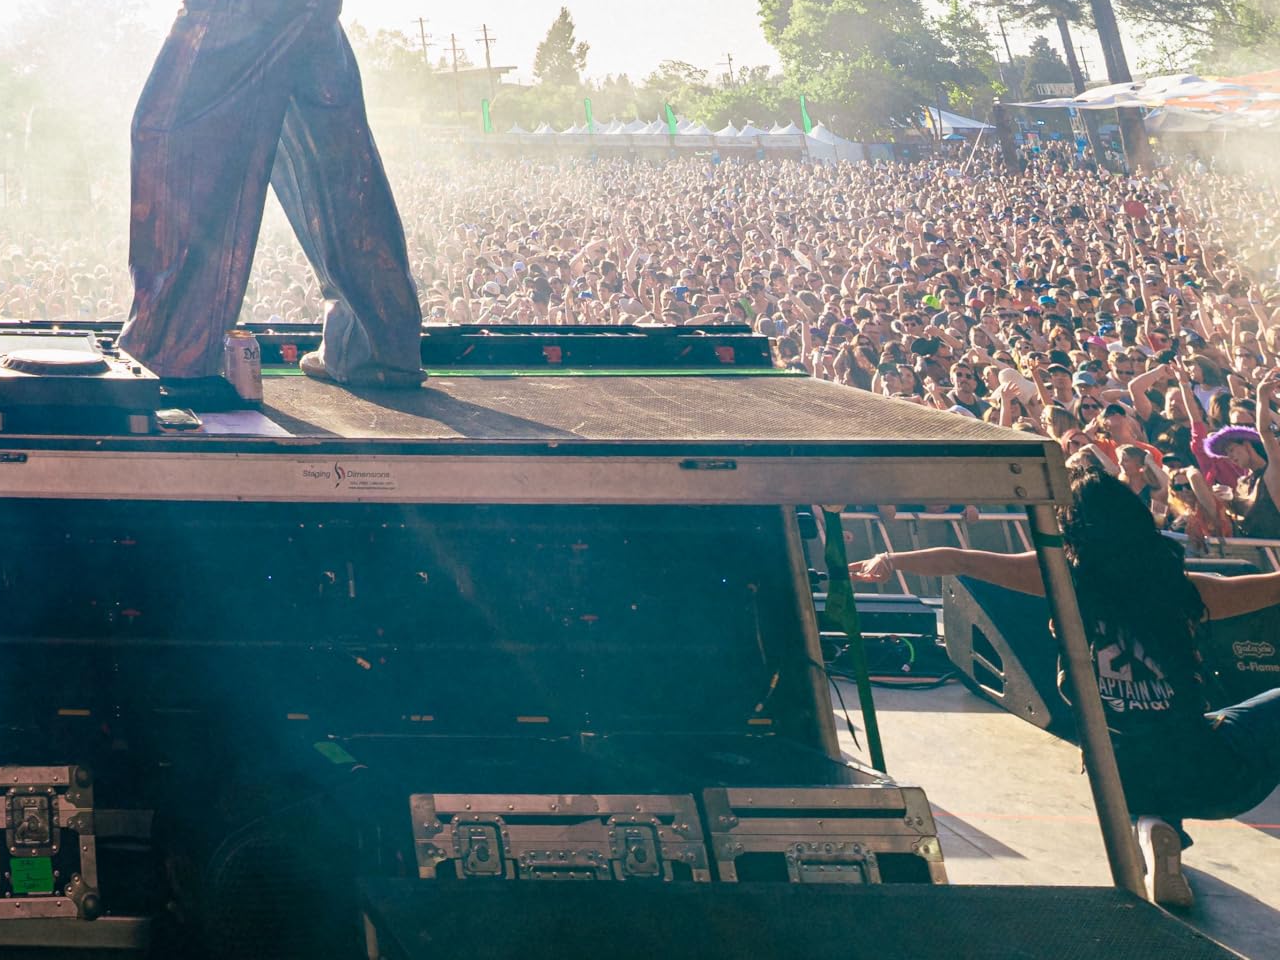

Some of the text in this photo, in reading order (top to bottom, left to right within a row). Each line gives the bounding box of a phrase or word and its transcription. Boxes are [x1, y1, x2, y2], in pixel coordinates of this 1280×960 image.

[303, 469, 390, 479] Staging Dimensions
[1099, 676, 1175, 701] APTAIN MA
